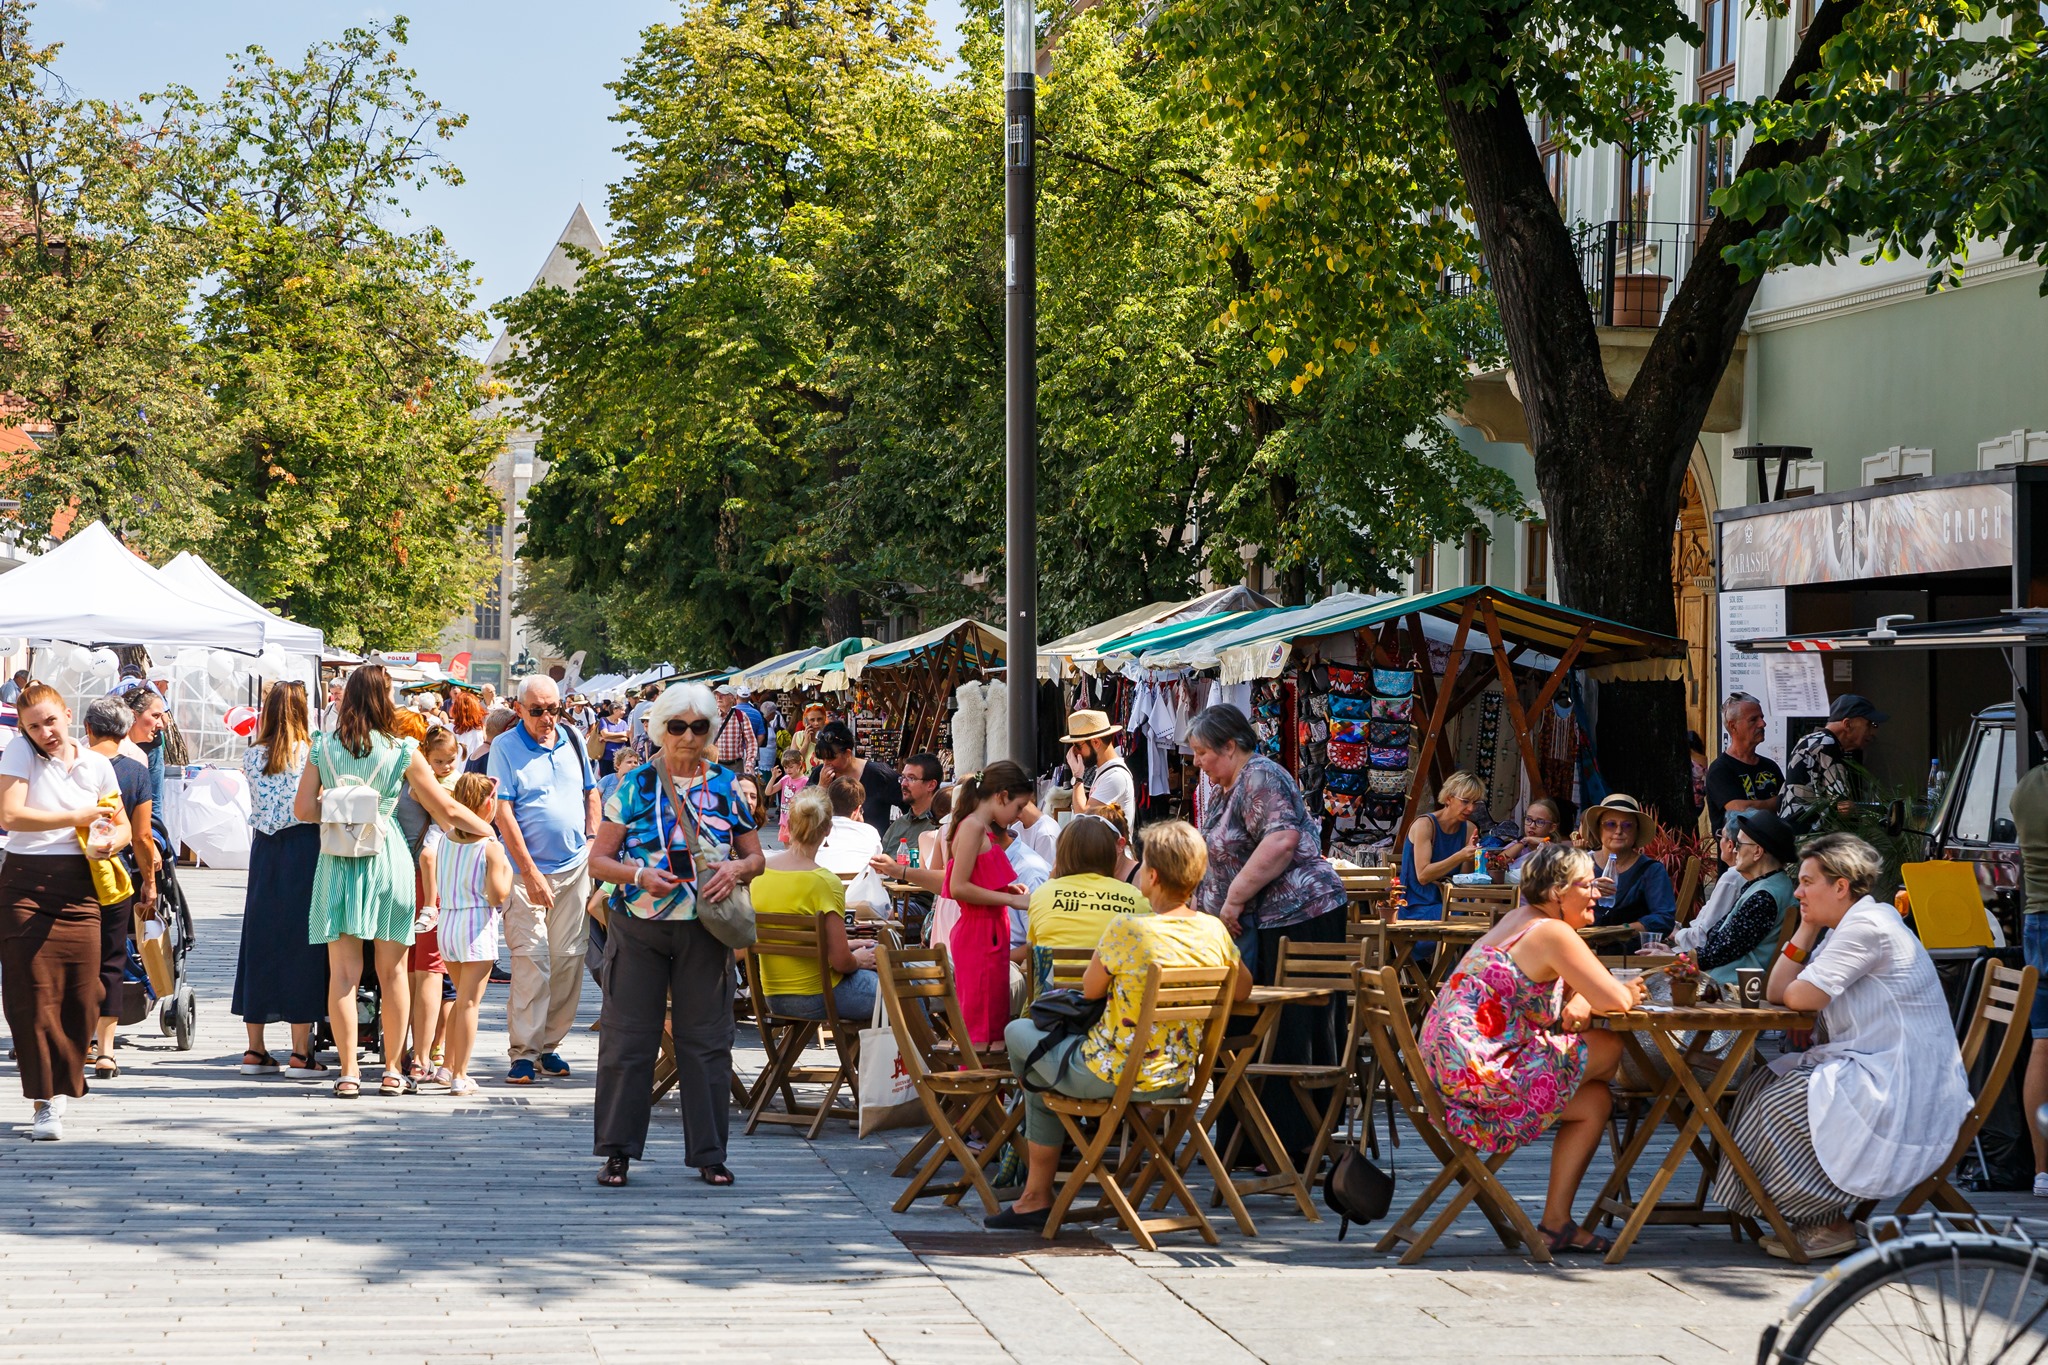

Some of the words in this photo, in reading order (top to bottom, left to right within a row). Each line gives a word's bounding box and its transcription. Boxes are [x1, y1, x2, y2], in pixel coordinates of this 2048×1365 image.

[1943, 505, 2002, 544] CRUSH
[1729, 552, 1770, 573] CARASSIA
[1054, 890, 1135, 905] Fotó-Videó
